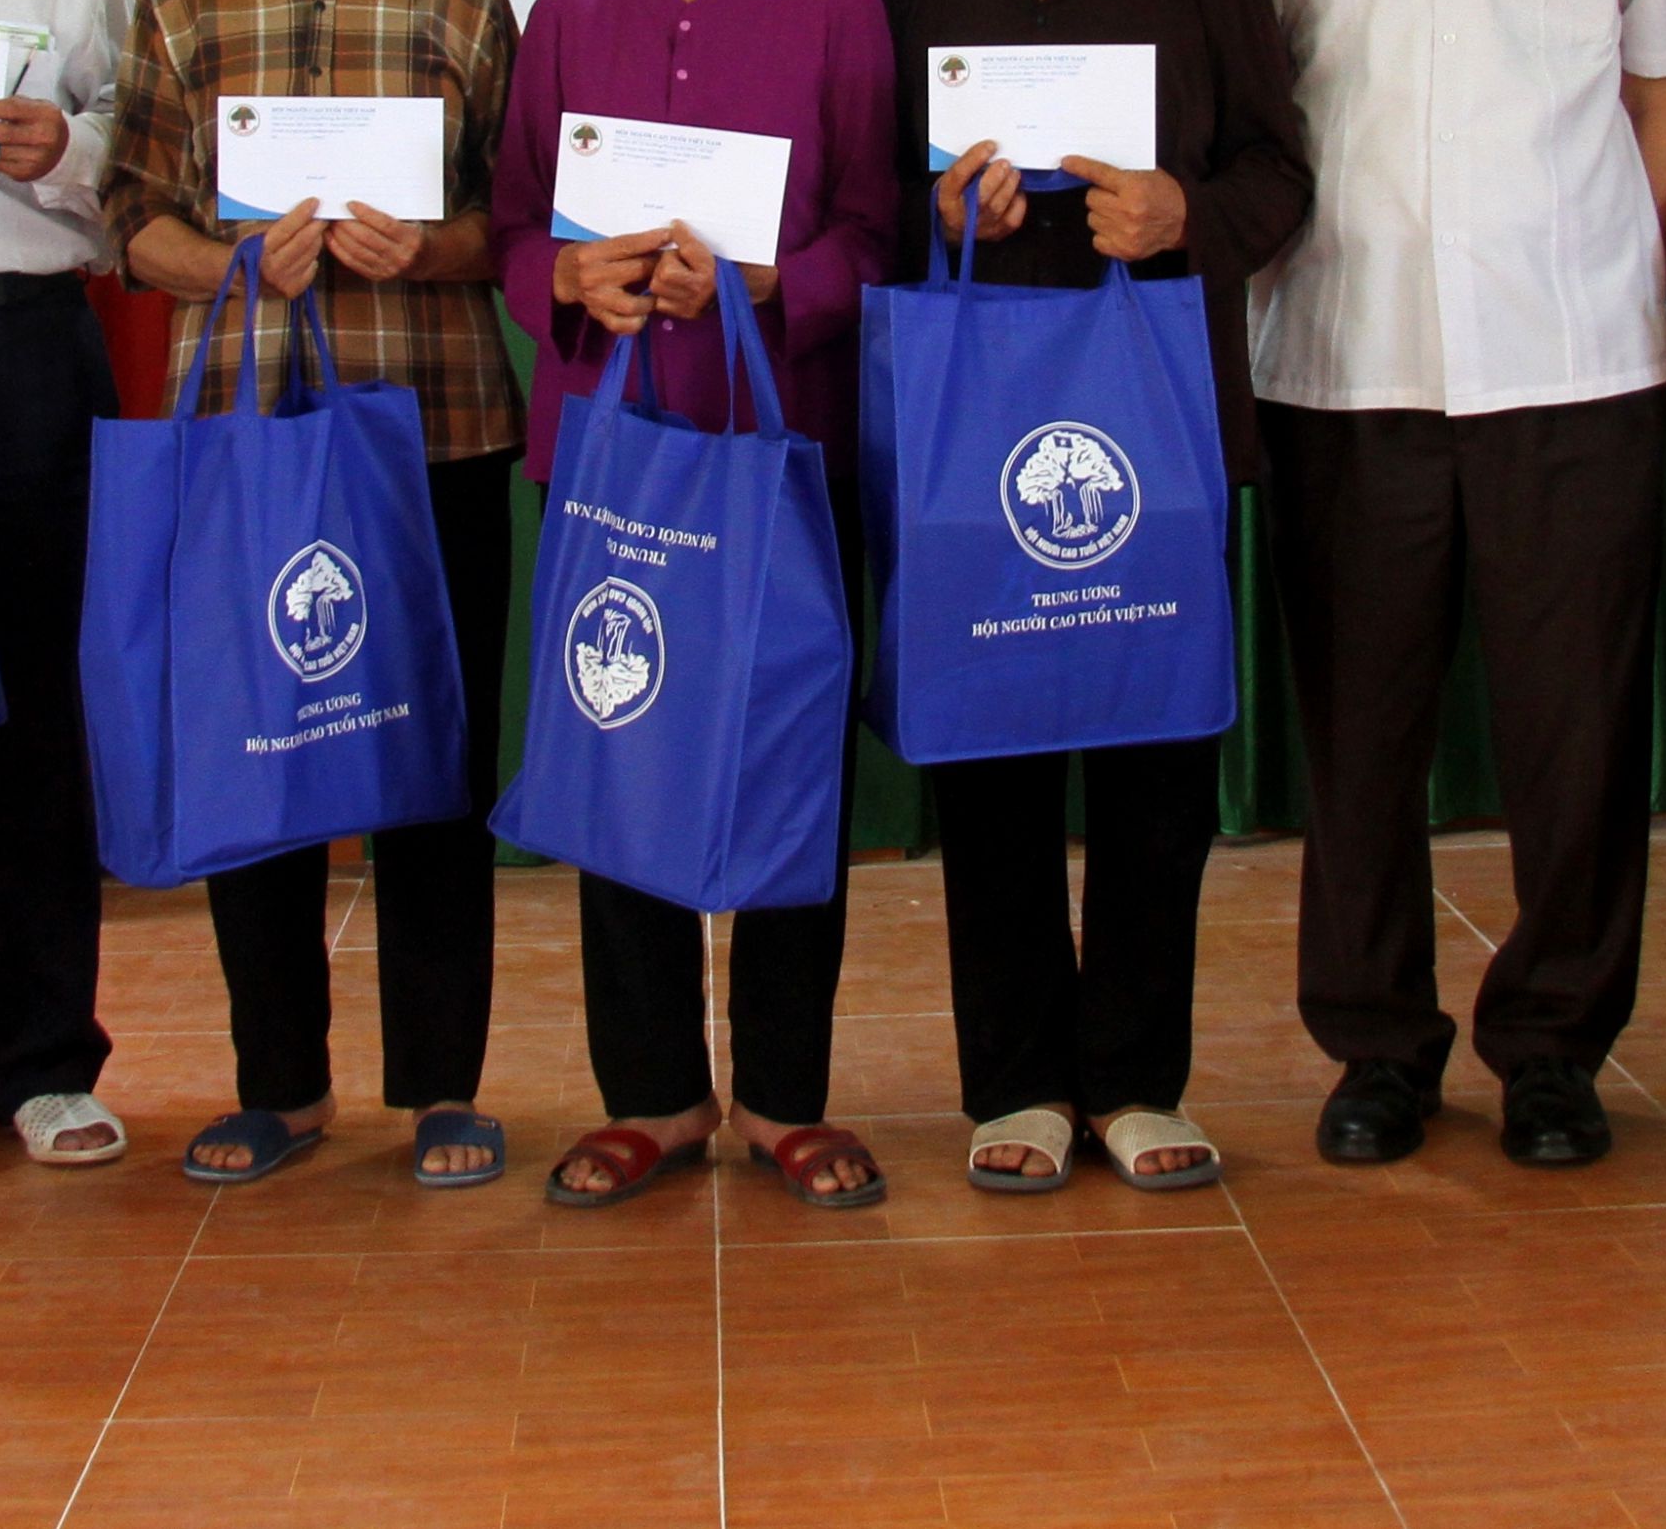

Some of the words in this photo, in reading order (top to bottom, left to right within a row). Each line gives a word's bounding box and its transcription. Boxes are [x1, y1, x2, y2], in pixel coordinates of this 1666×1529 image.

[627, 520, 655, 539] CAO
[618, 545, 667, 567] TRUNG
[1032, 589, 1078, 607] TRUNG
[1082, 584, 1121, 601] ƯƠNG
[972, 618, 998, 639] HỘI
[1001, 614, 1046, 634] NGƯỜI
[1050, 612, 1076, 629] CAO
[1078, 604, 1112, 625] TUỔI
[1115, 603, 1145, 623] VIỆT
[1147, 601, 1177, 617] NAM
[326, 693, 362, 711] ƯƠNG
[246, 734, 269, 755] HỘI
[303, 725, 325, 743] CAO
[326, 713, 356, 737] TUỔI
